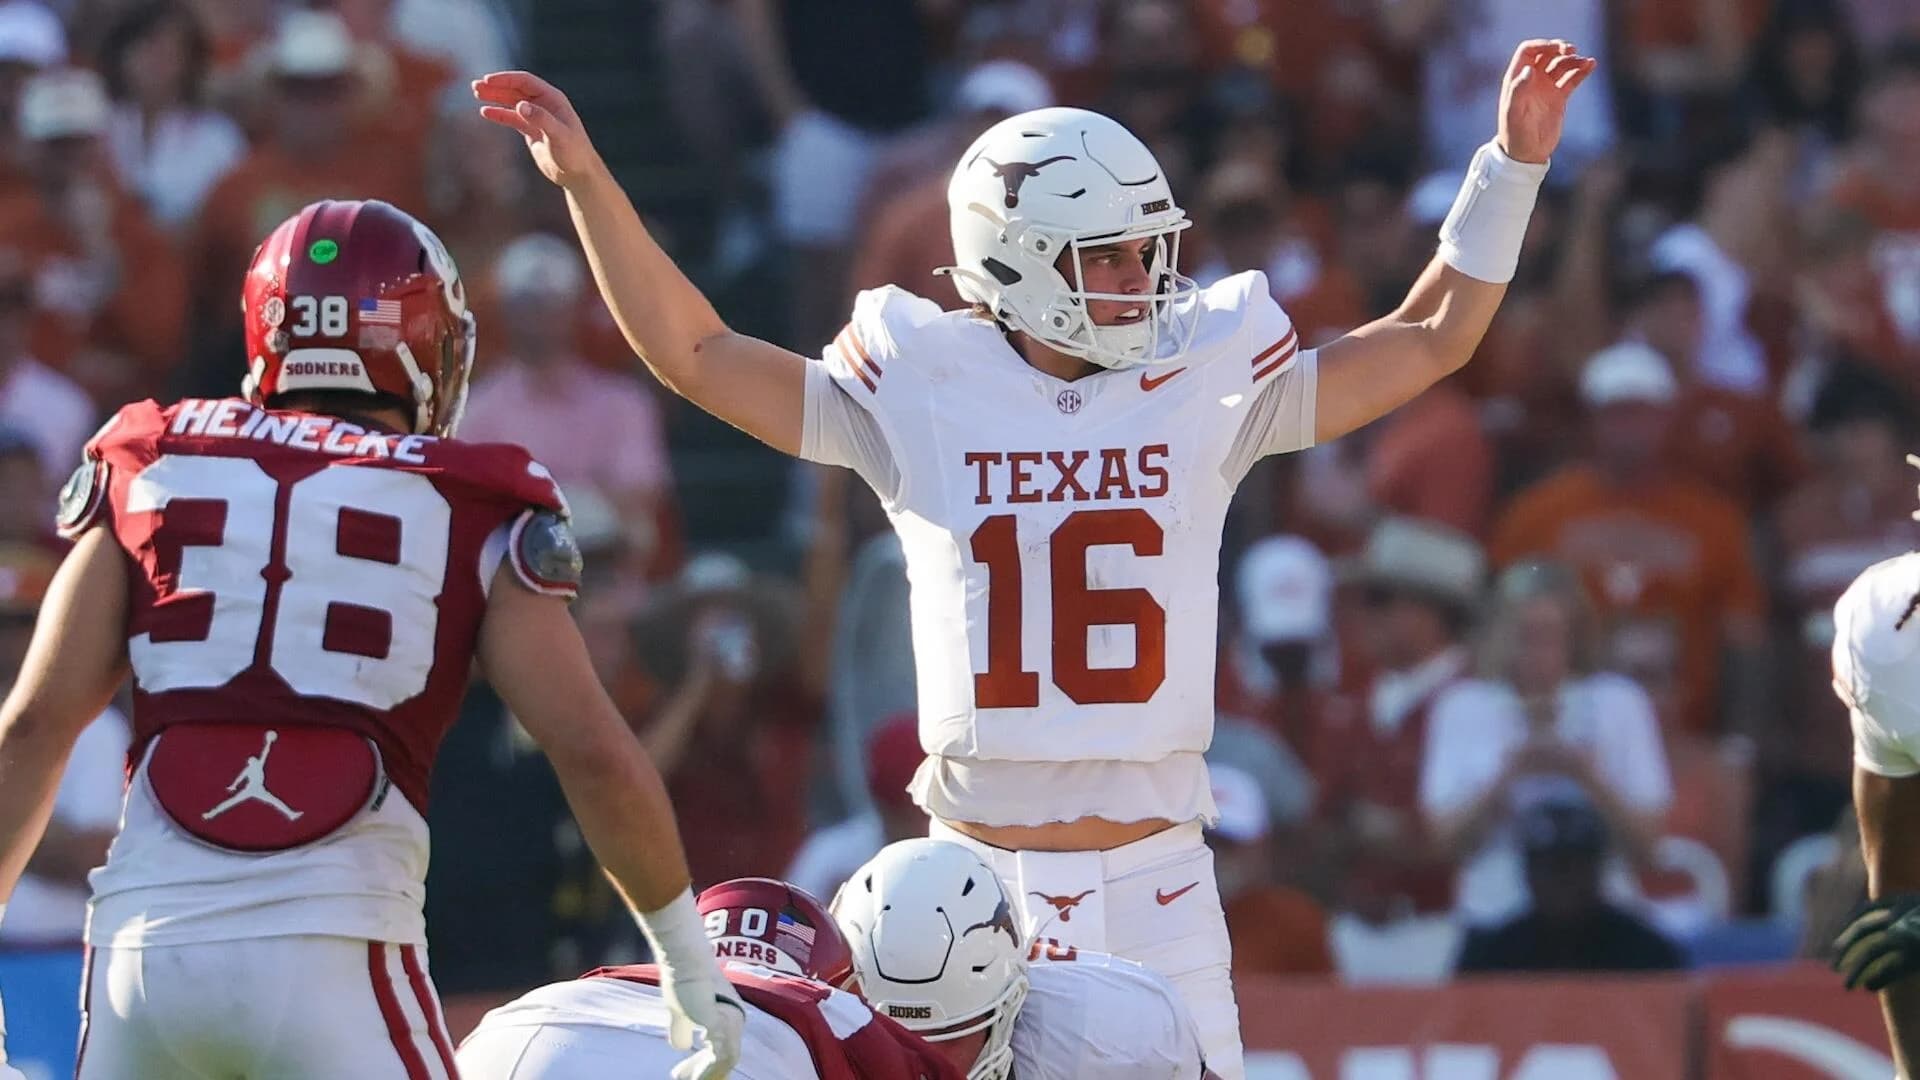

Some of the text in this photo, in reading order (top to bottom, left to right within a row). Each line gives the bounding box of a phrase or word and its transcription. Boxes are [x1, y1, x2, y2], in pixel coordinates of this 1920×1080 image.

[292, 295, 348, 337] 38
[285, 361, 361, 377] SOONERS
[1058, 390, 1081, 413] SEC
[171, 399, 438, 464] HEINECKE
[964, 443, 1169, 505] TEXAS
[126, 454, 452, 712] 38
[969, 508, 1166, 709] 16
[704, 907, 769, 938] 90
[715, 941, 778, 965] NERS
[888, 1005, 932, 1019] HORNS
